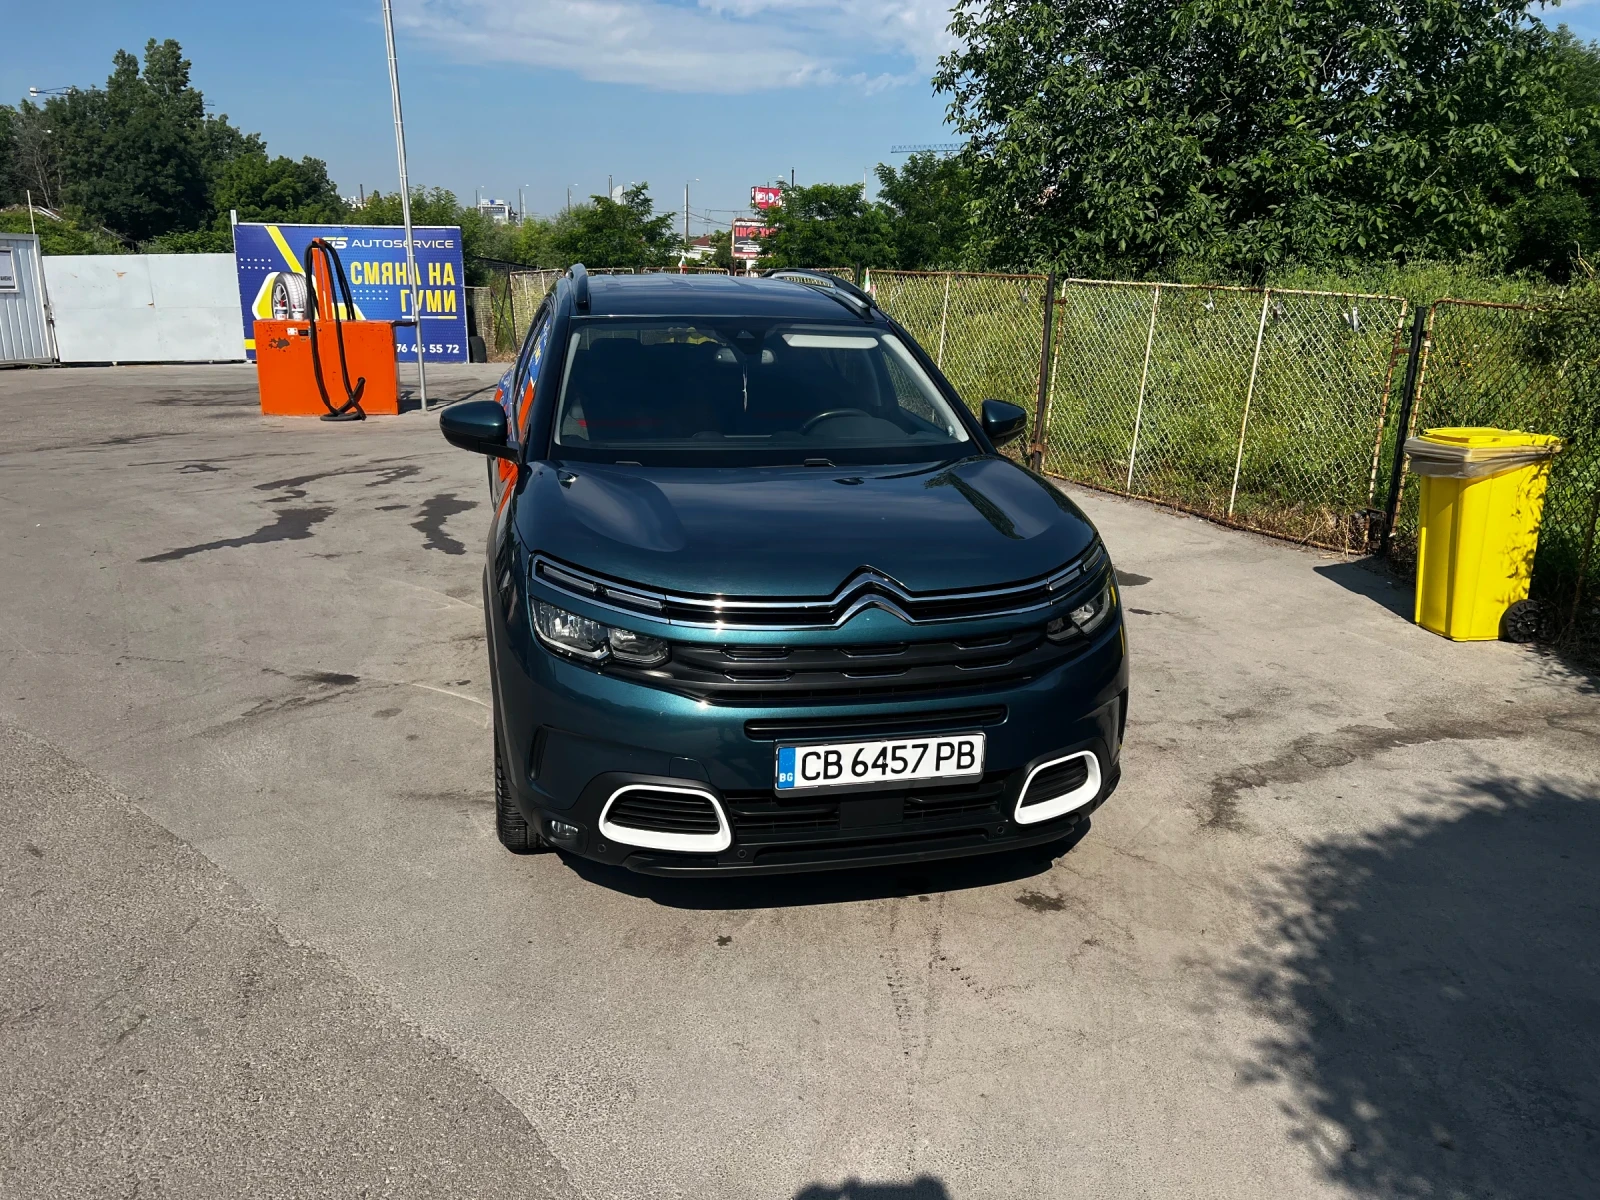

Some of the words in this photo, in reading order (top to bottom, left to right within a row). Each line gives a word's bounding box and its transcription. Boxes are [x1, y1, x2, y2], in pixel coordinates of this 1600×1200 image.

[428, 262, 456, 286] НА
[429, 343, 443, 353] 55
[446, 344, 460, 354] 72
[801, 749, 843, 781] CB
[851, 743, 929, 778] 6457
[935, 740, 975, 772] PB
[779, 772, 794, 783] BG
